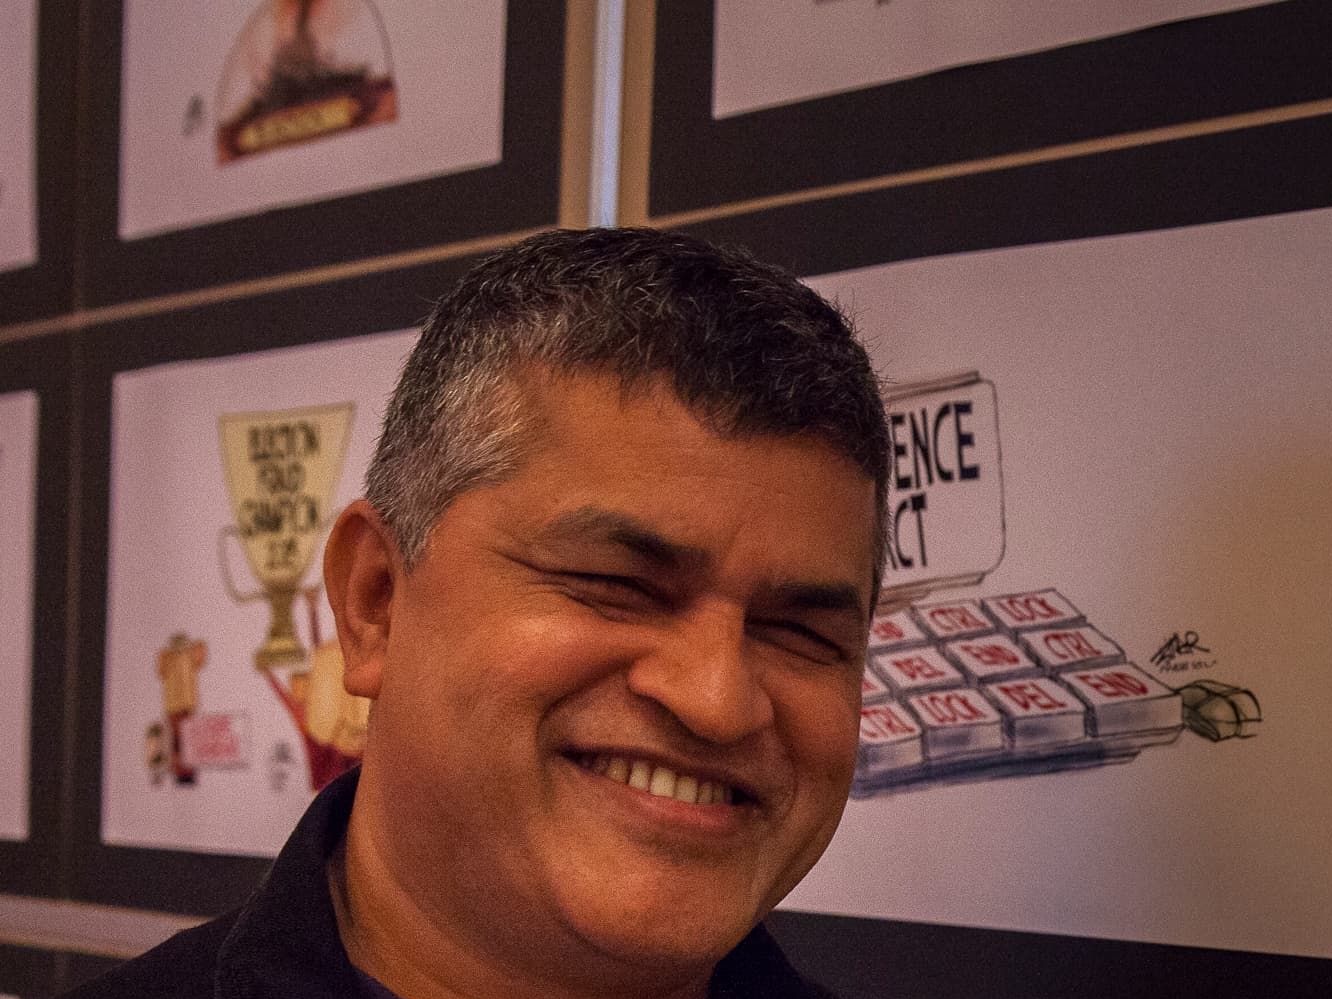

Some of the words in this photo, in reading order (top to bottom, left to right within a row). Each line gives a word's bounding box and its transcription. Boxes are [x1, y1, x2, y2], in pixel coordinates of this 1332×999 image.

[883, 493, 927, 571] CT
[929, 606, 989, 632] CTRL
[997, 595, 1064, 622] LOCK
[1044, 631, 1102, 660] CTRL
[998, 682, 1067, 710] DEL
[1075, 672, 1149, 697] END
[919, 693, 987, 723] LOCK
